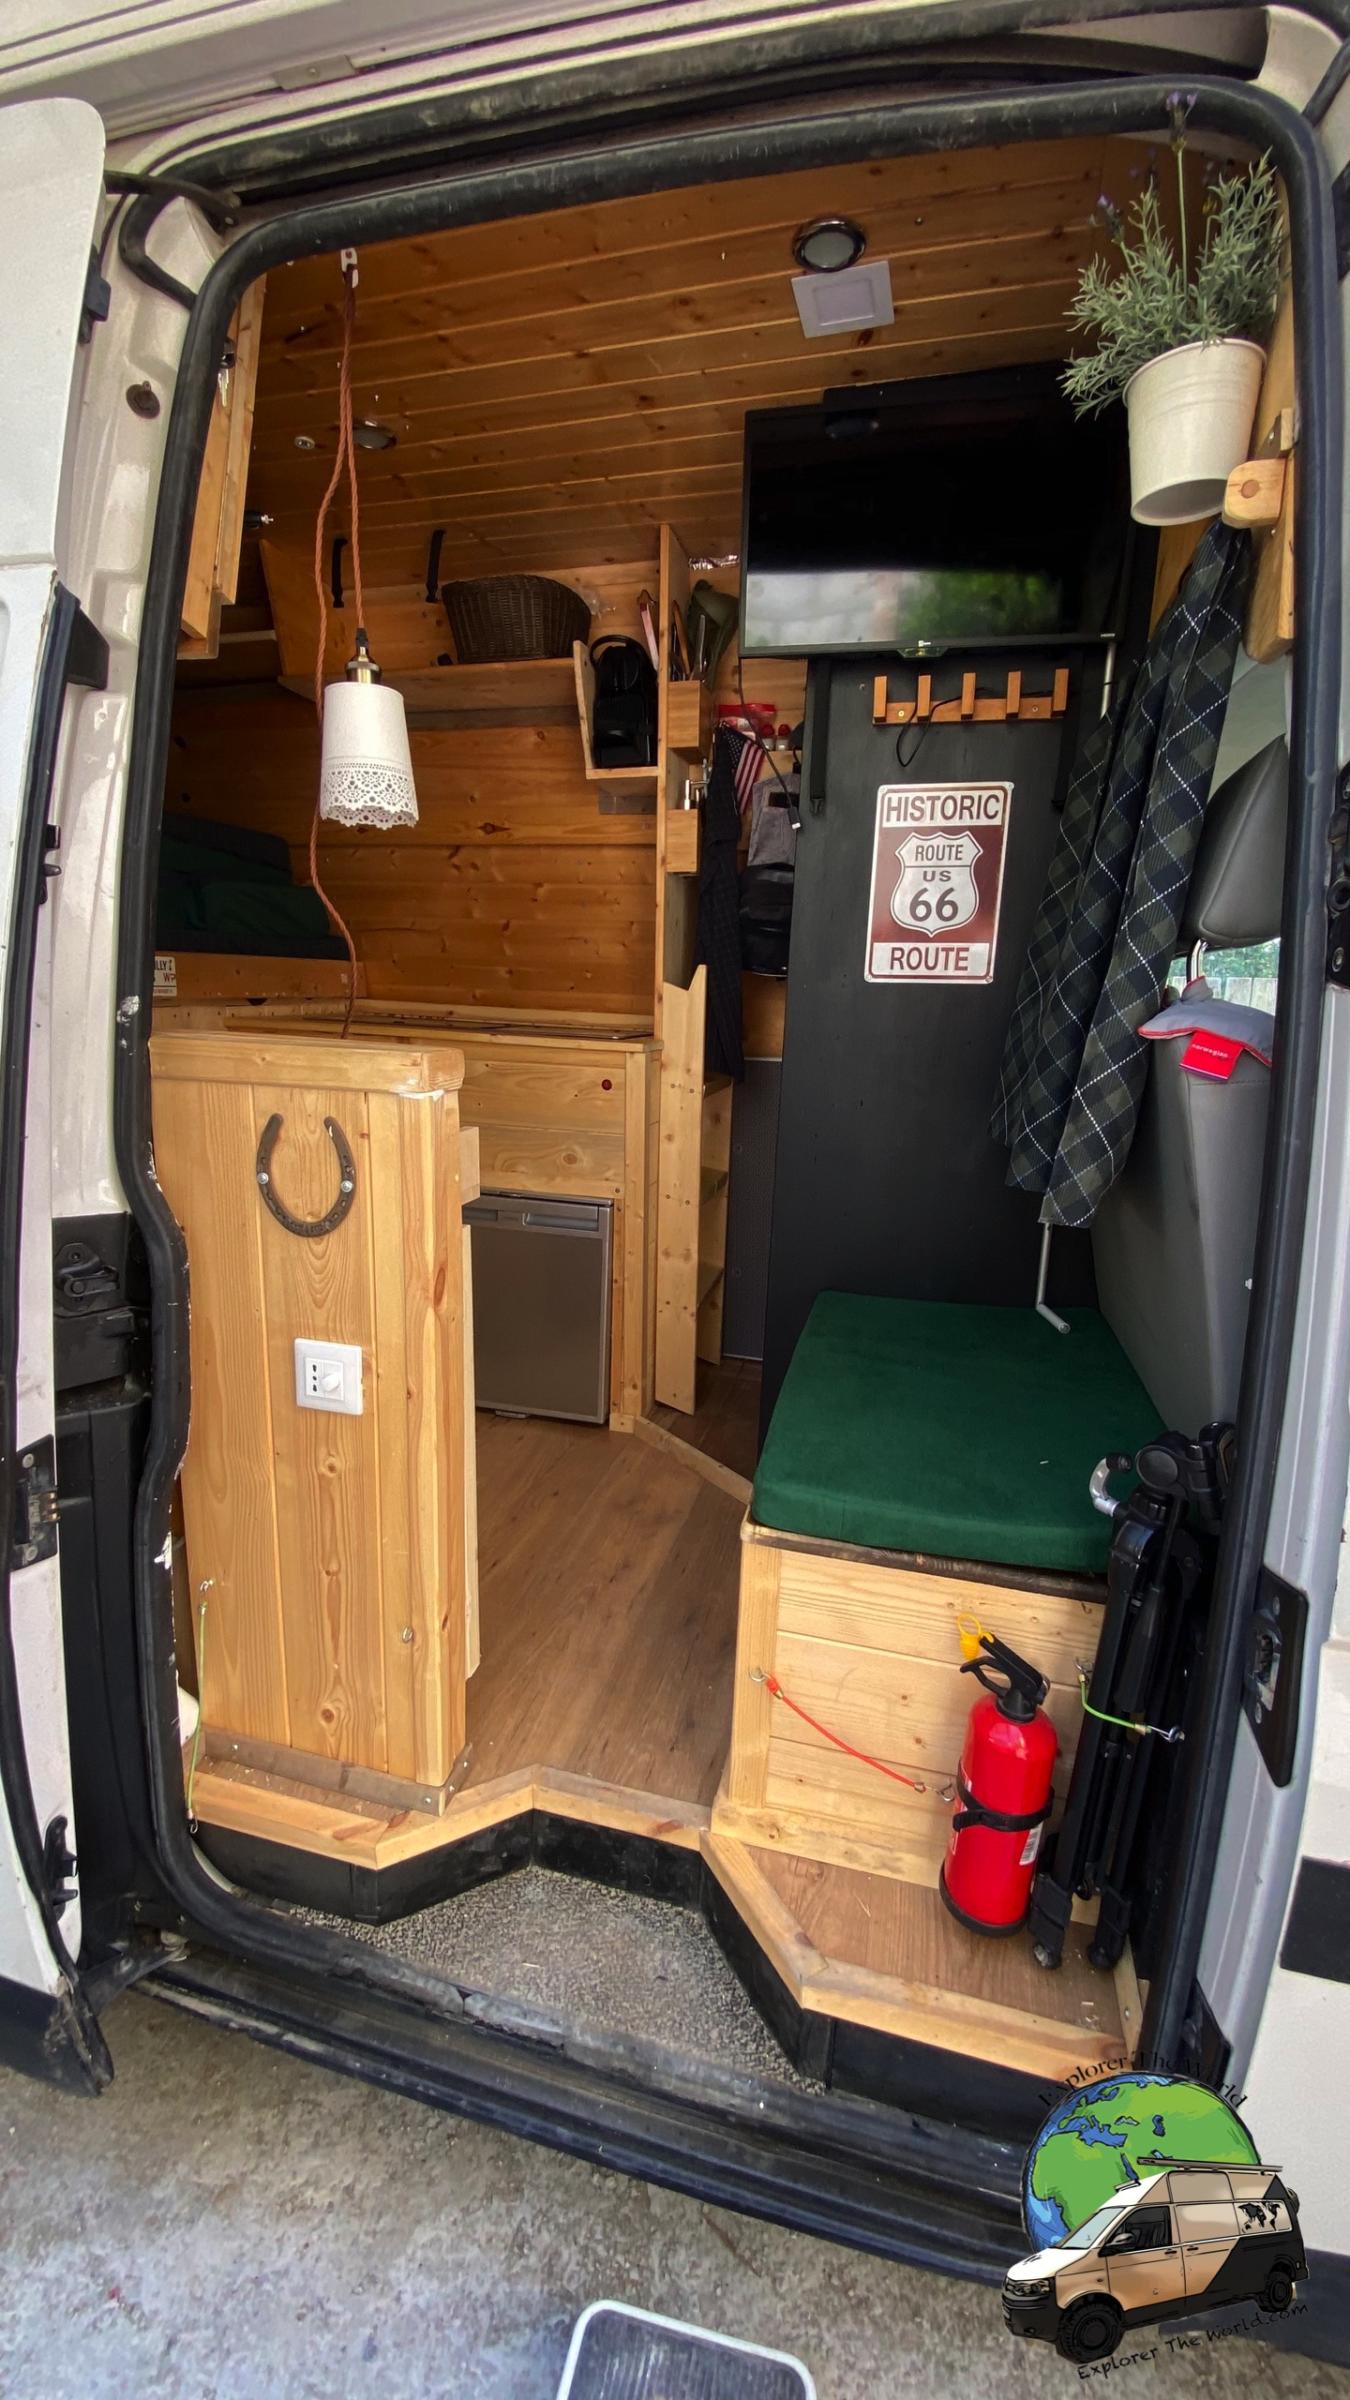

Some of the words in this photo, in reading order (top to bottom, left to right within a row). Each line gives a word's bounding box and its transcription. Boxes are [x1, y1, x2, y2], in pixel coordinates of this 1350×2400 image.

[886, 794, 1000, 823] HISTORIC
[914, 844, 964, 862] ROUTE
[923, 870, 952, 882] US
[909, 887, 959, 922] 66
[890, 946, 970, 971] ROUTE
